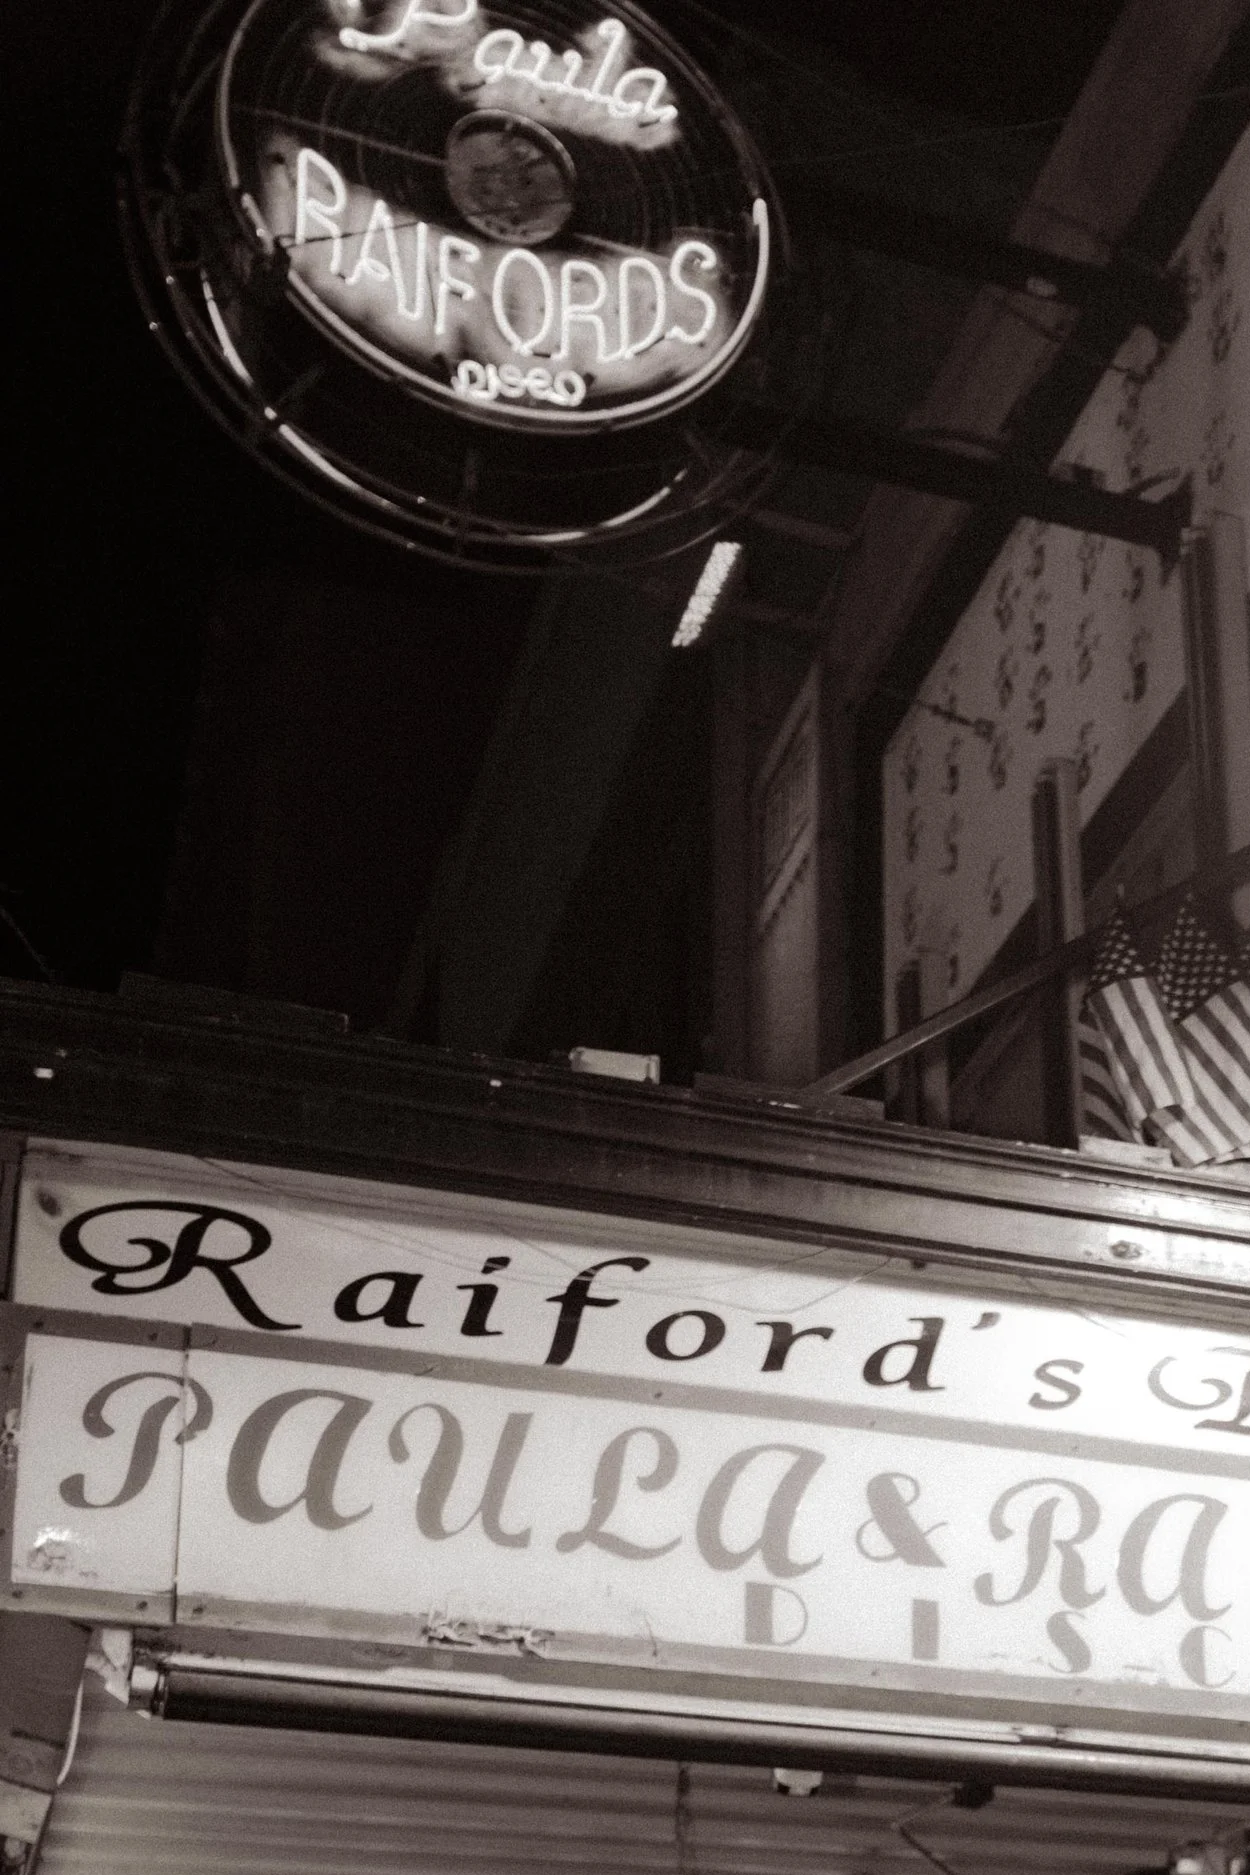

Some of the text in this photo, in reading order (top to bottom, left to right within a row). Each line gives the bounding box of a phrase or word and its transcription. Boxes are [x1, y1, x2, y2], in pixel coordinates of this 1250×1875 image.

[294, 147, 718, 362] RAIFORDS
[58, 1201, 1084, 1411] Raiford's
[58, 1371, 827, 1580] PAULA
[854, 1472, 948, 1571] &
